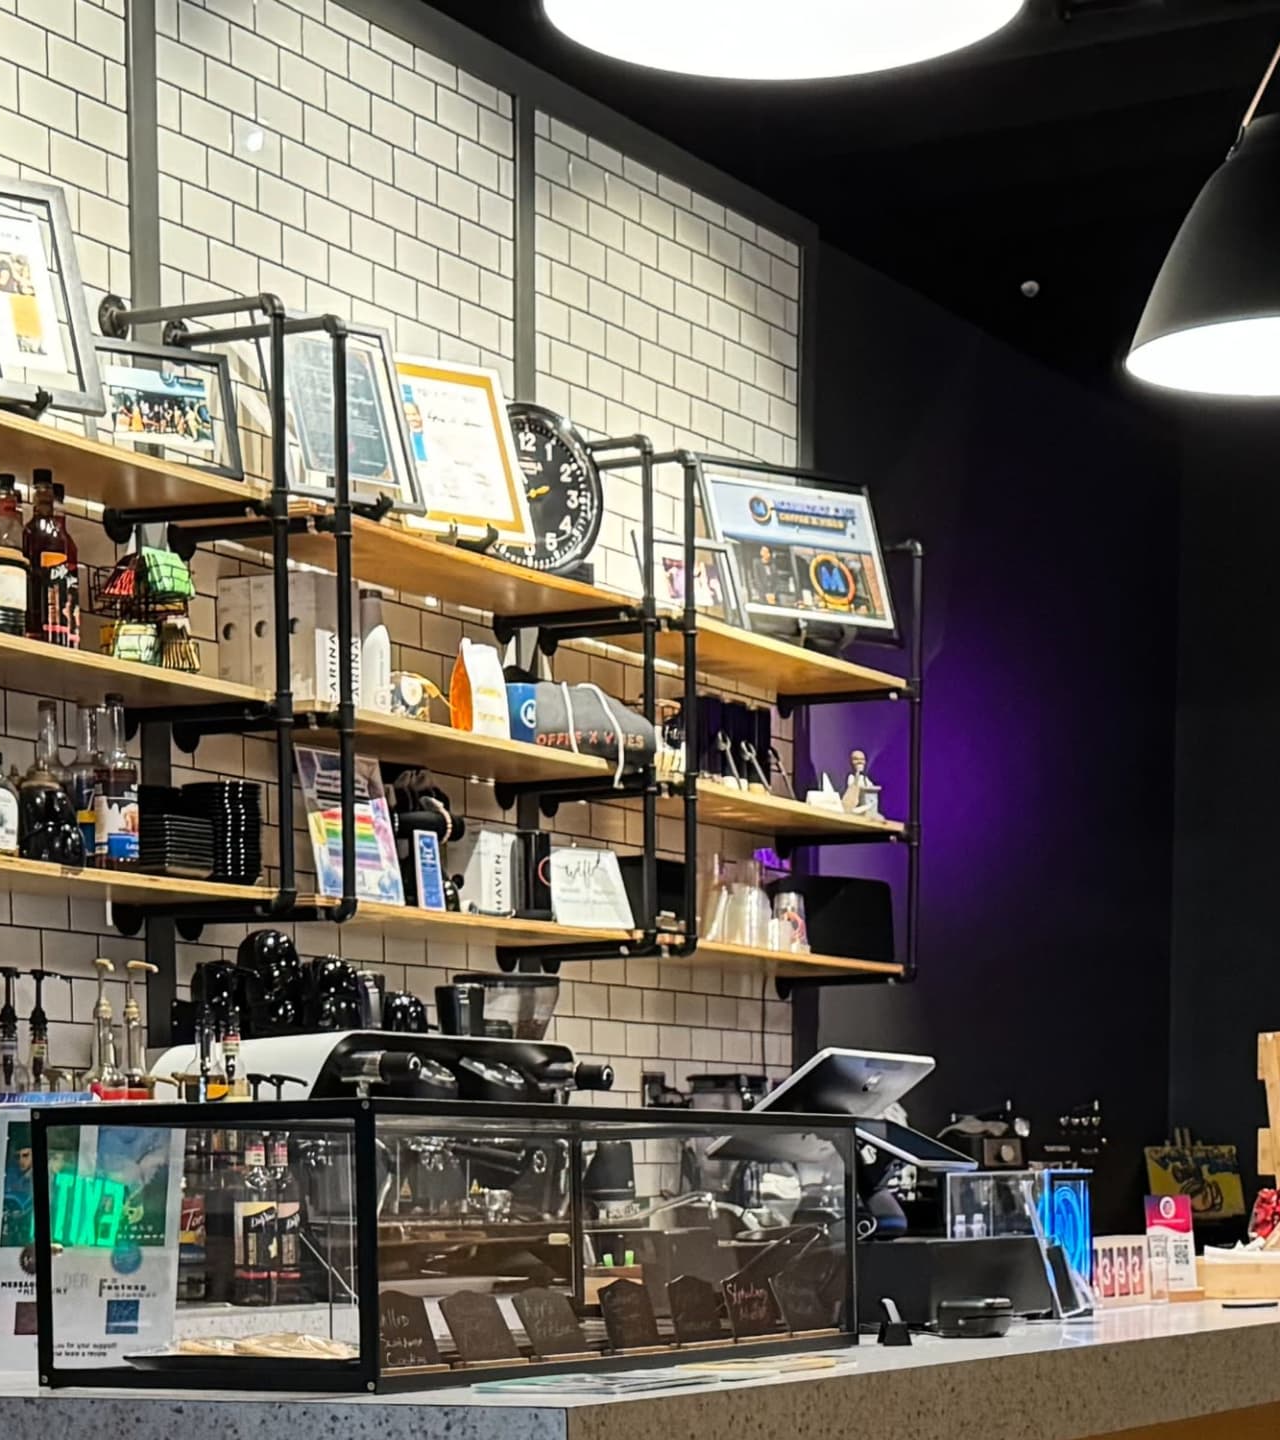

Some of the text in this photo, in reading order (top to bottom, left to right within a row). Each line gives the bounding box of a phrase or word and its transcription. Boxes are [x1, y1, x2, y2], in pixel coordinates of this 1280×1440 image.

[560, 463, 572, 483] 2
[566, 489, 579, 509] 3
[559, 515, 572, 535] 4
